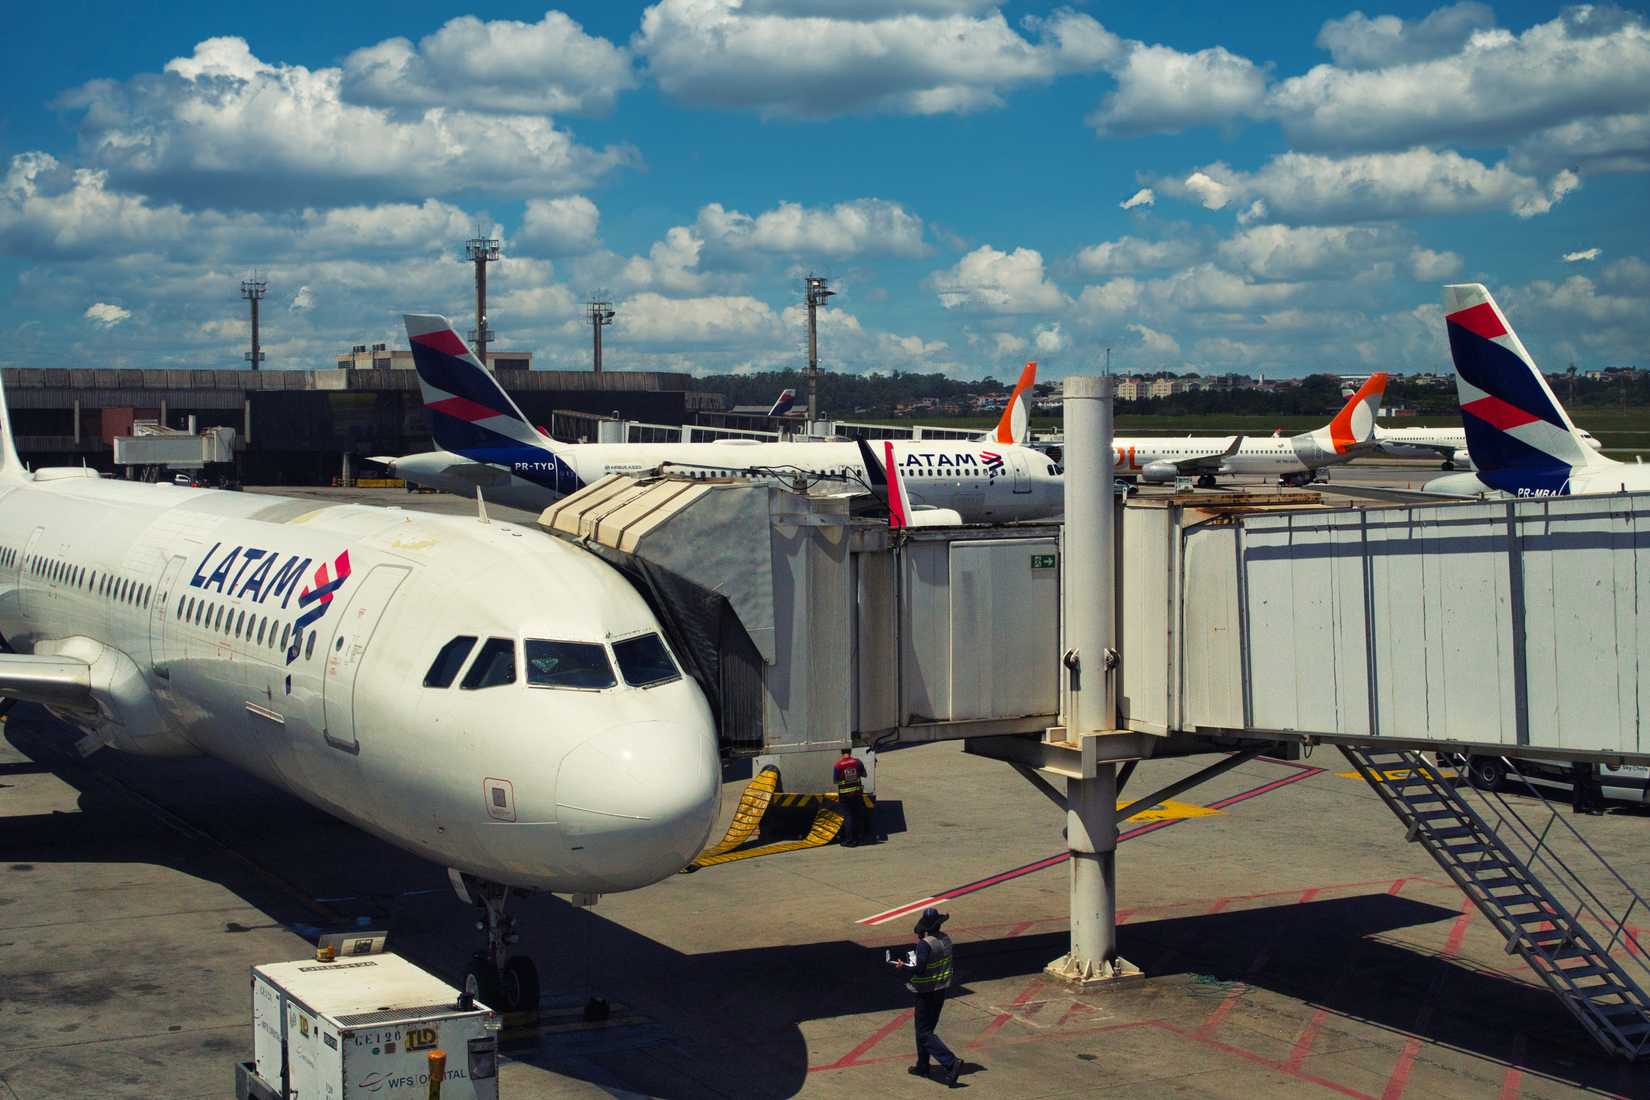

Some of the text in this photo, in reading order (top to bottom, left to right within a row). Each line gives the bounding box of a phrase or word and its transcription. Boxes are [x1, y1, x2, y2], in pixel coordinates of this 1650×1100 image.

[514, 462, 555, 471] PR-TYD
[898, 453, 978, 467] ATAM
[190, 542, 312, 609] LATAM
[406, 1028, 438, 1048] TLD
[388, 1076, 414, 1089] WFS
